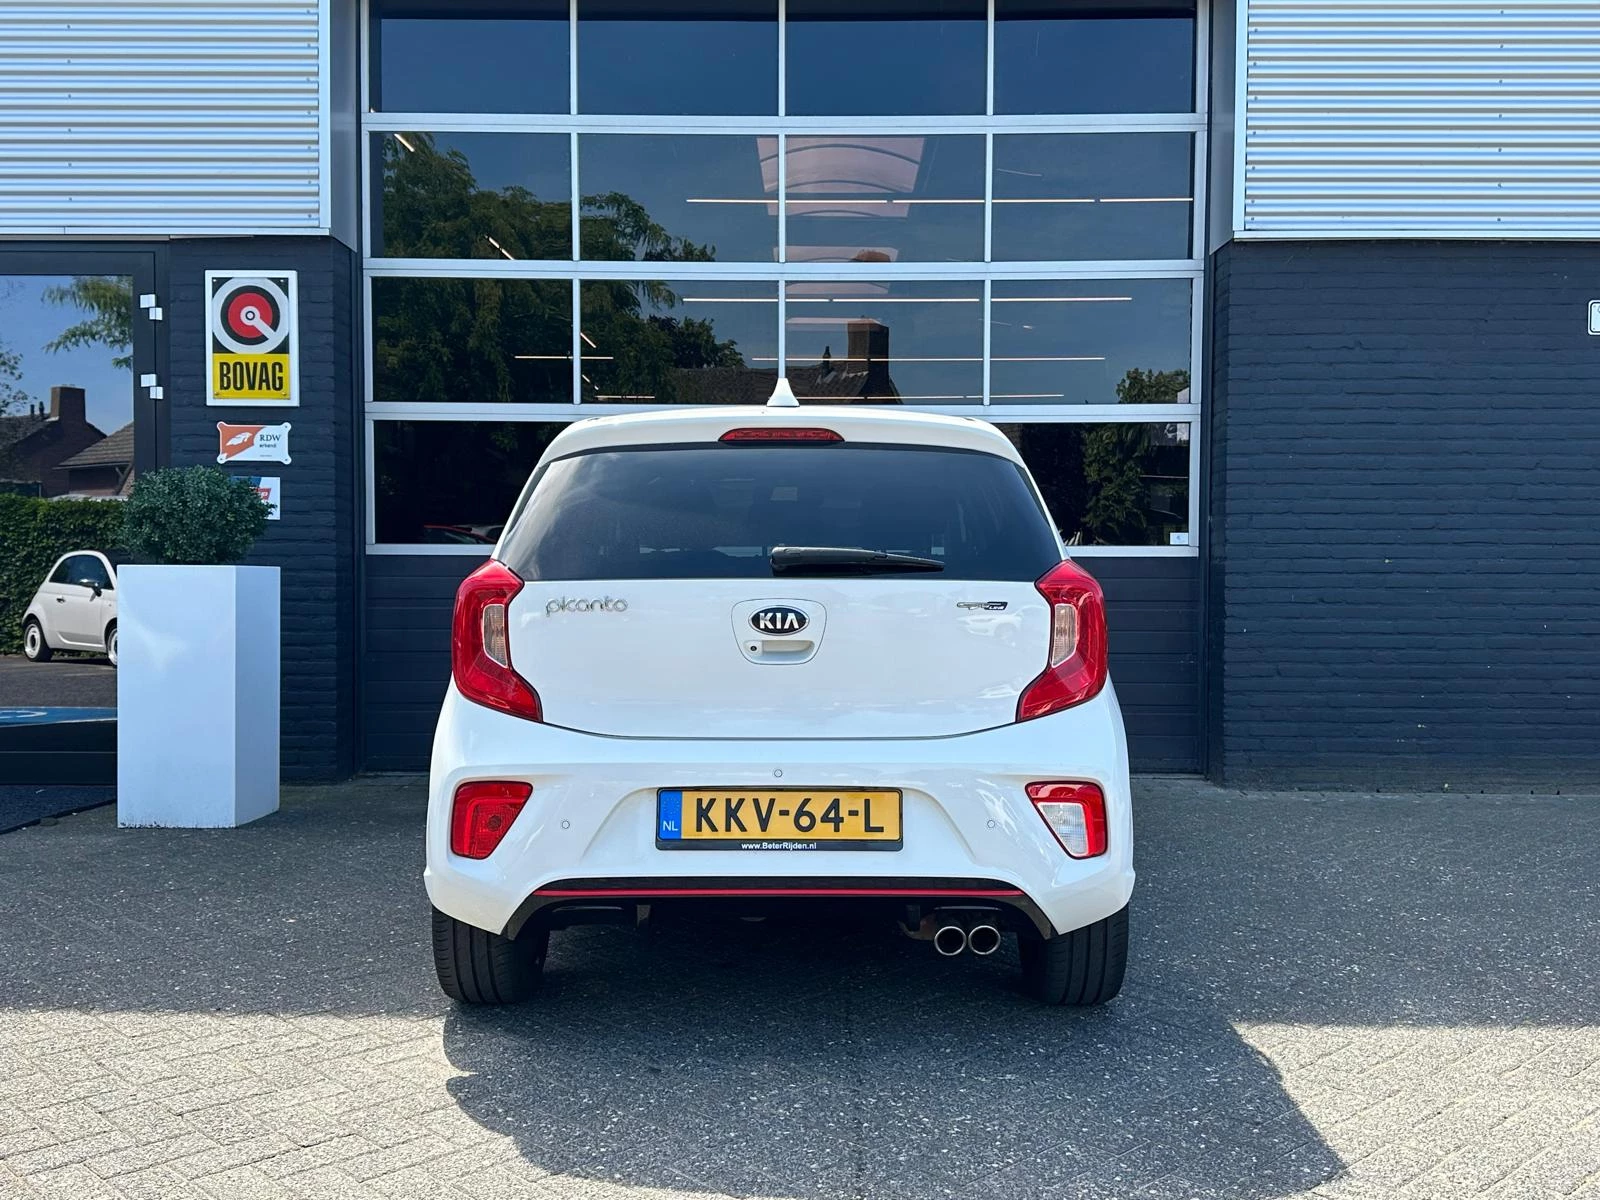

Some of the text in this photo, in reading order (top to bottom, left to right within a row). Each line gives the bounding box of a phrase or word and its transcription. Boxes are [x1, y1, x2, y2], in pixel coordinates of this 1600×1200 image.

[219, 361, 284, 391] BOVAG
[545, 596, 628, 617] picanto
[759, 612, 800, 629] KIA
[695, 797, 884, 833] KKV-64-L
[662, 820, 679, 831] NL
[741, 842, 817, 851] www.BeterRijden.nl
